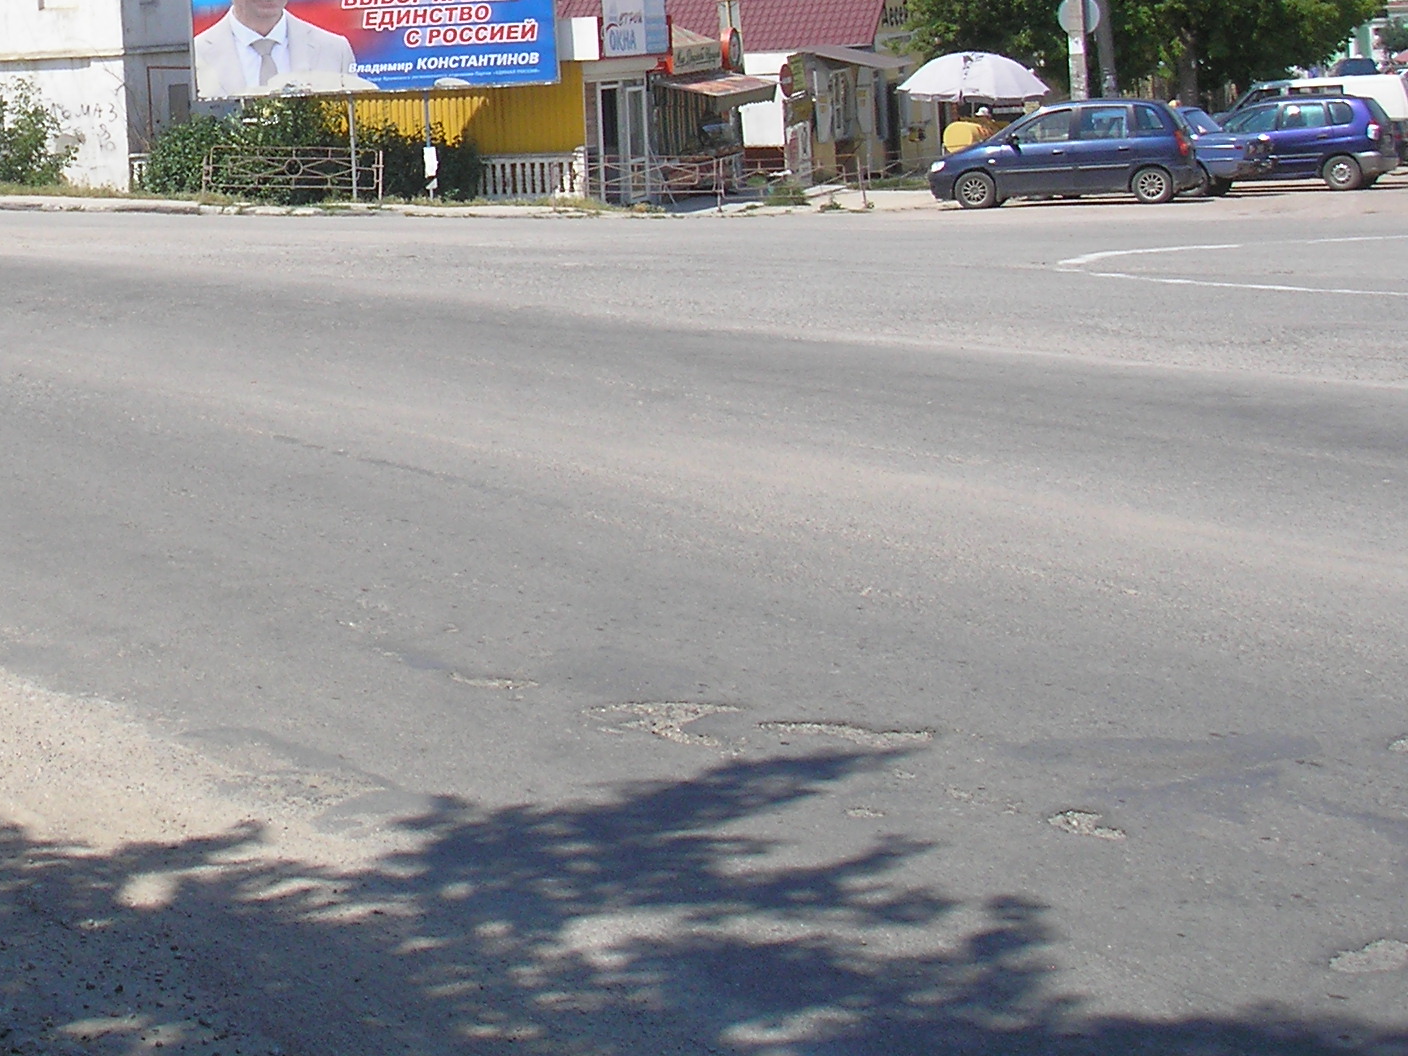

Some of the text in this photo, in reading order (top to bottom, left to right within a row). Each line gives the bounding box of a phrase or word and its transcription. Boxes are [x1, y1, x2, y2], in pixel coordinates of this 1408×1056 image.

[364, 5, 490, 29] ЕДИНСТВО
[405, 19, 537, 46] С РОССИЕЙ
[609, 29, 637, 51] ОКНА
[349, 52, 540, 74] Владимир КОНСТАНТИНОВ
